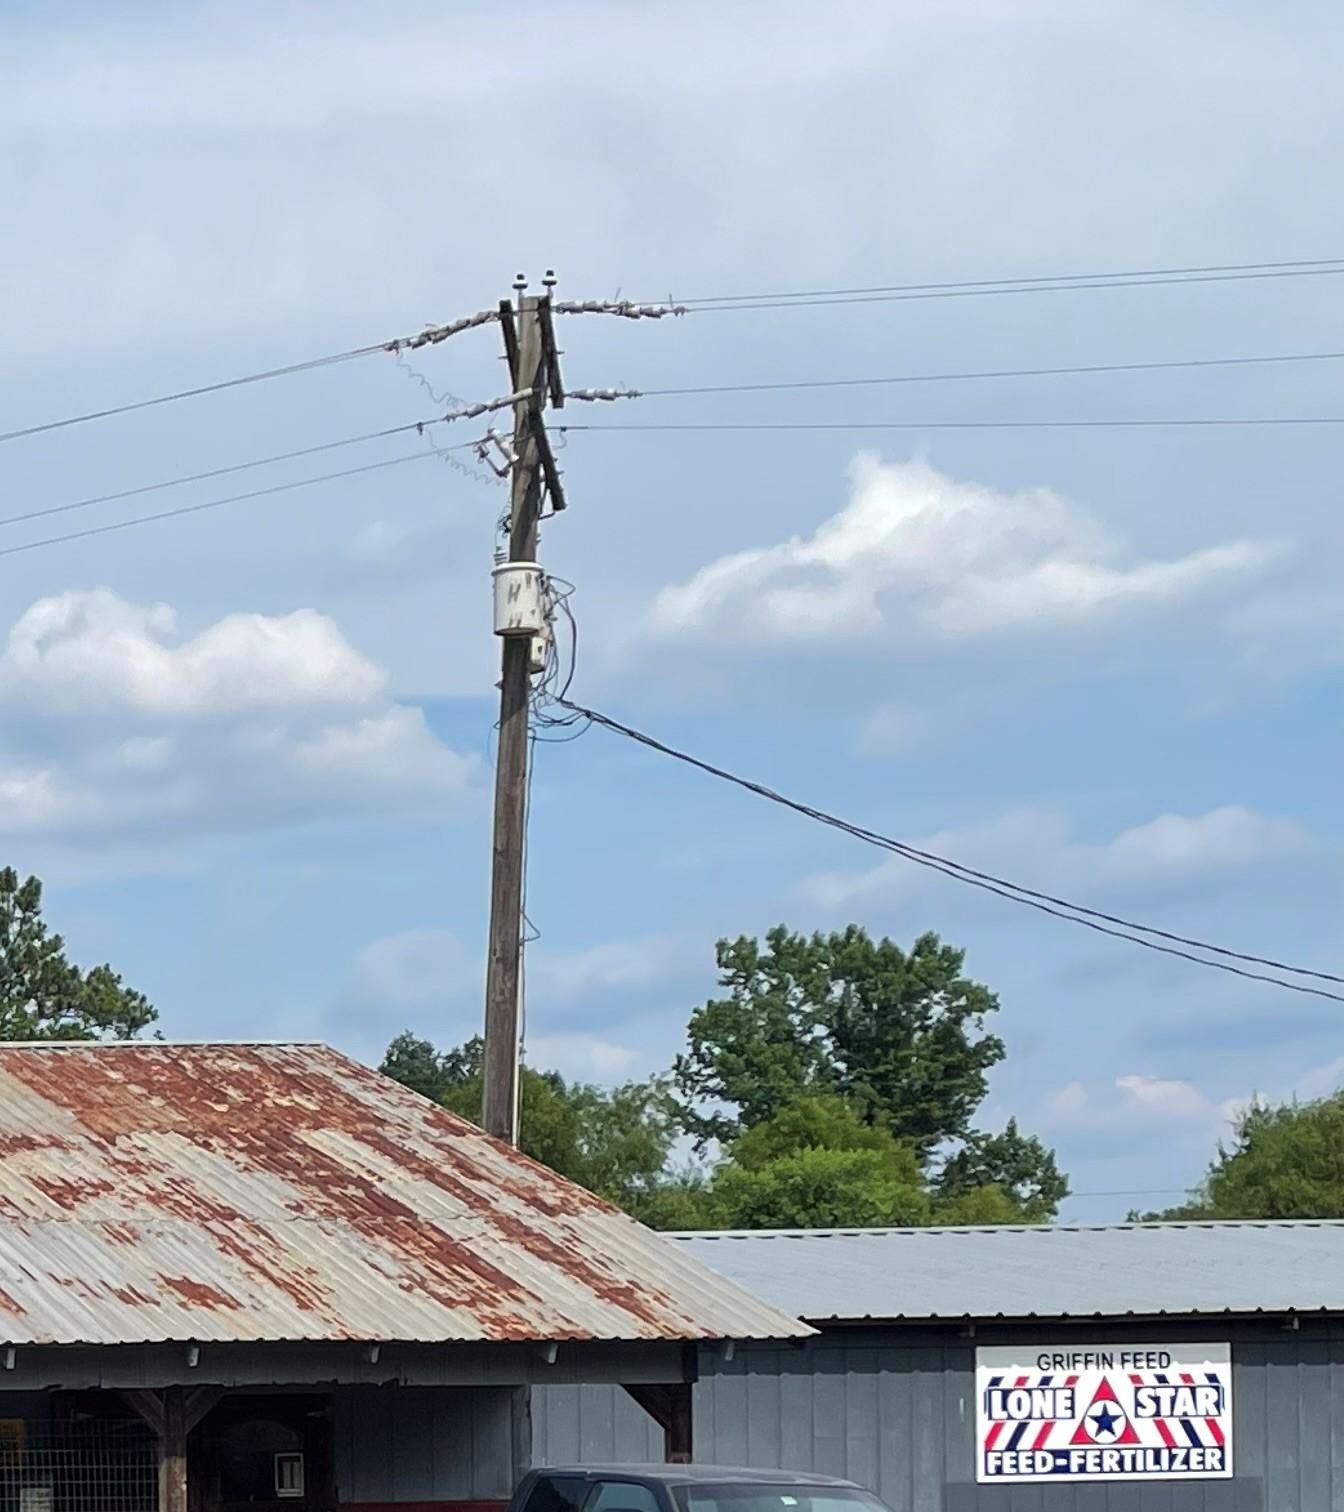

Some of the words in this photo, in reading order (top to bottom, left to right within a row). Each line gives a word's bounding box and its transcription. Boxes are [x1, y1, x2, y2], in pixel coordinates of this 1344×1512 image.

[1036, 1352, 1114, 1371] GRIFFIN
[1120, 1351, 1172, 1370] FEED
[990, 1388, 1074, 1420] LONE
[1136, 1386, 1220, 1417] STAR
